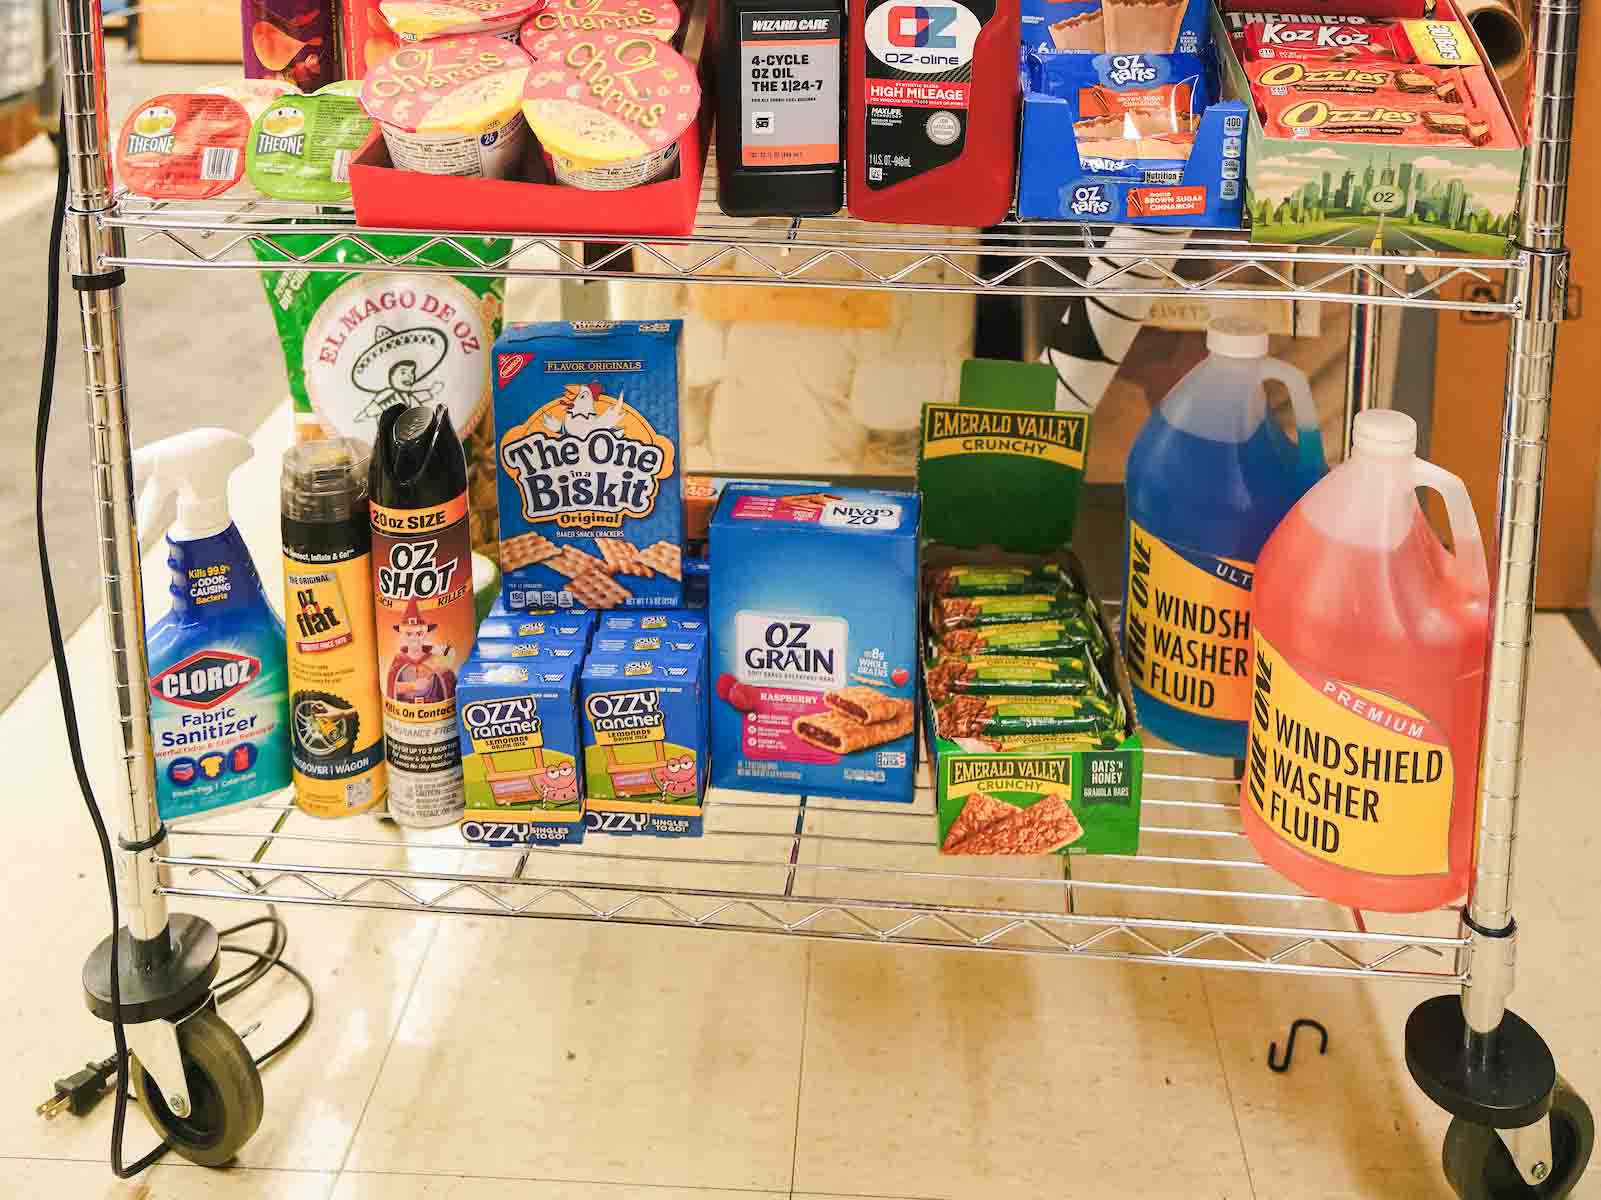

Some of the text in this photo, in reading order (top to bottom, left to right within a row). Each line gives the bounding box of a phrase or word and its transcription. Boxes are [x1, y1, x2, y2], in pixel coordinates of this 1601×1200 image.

[536, 7, 657, 32] Charms
[752, 19, 830, 31] WIZARD CARE
[887, 5, 958, 49] OZ
[1262, 23, 1369, 47] Koz Koz
[1038, 42, 1049, 55] 6
[1180, 45, 1197, 53] USA
[751, 54, 809, 66] 4-CYCLE
[885, 53, 959, 65] OZ-oline
[1112, 55, 1145, 70] OZ
[373, 52, 506, 97] Charms
[751, 67, 794, 79] OZ OIL
[1110, 65, 1156, 85] tarts
[1260, 63, 1388, 86] Ozzies
[565, 42, 667, 128] Charms
[751, 81, 778, 92] THE
[870, 85, 964, 101] HIGH MILEAGE
[871, 107, 902, 115] MAXLIFE
[1281, 101, 1418, 127] Ozzies
[1226, 118, 1241, 127] 400
[128, 134, 175, 154] THEONE
[258, 134, 304, 155] THEONE
[483, 135, 496, 145] 26
[1146, 171, 1177, 181] Nutrition
[1075, 186, 1101, 202] OZ
[1144, 194, 1203, 204] BROWN SUGAR
[1071, 198, 1110, 215] tarts
[1149, 202, 1195, 210] CINNAMON
[320, 335, 347, 366] EL
[340, 289, 417, 332] MAGO
[420, 293, 458, 324] DE
[453, 320, 482, 355] OZ
[547, 361, 642, 371] FLAVOR ORIGINALS
[933, 410, 1080, 449] EMERALD VALLEY
[962, 438, 1048, 455] CRUNCHY
[508, 434, 659, 477] The One
[526, 470, 649, 513] Biskit
[373, 510, 446, 529] 20 SIZE
[560, 513, 619, 524] Original
[832, 506, 894, 517] GRAIN
[847, 515, 879, 525] OZ
[576, 530, 595, 538] SNACK
[596, 530, 625, 538] CRACKERS
[311, 552, 331, 561] Inflate
[390, 540, 438, 572] OZ
[189, 568, 207, 579] Kills
[197, 574, 228, 588] ODOR-
[289, 574, 329, 584] THE ORIGINAL
[379, 558, 458, 598] SHOT
[1131, 537, 1152, 609] ONE
[190, 582, 232, 598] CAUSING
[1154, 587, 1250, 641] WINDSH
[764, 622, 811, 648] OZ
[871, 648, 885, 660] 8g
[1153, 625, 1249, 677] WASHER
[745, 647, 834, 675] GRAIN
[859, 657, 889, 669] WHOLE
[162, 659, 251, 699] CLOROZ
[857, 665, 888, 677] GRAINS
[1151, 661, 1216, 709] FLUID
[589, 691, 658, 718] OZZY
[760, 692, 818, 705] RASPBERRY
[182, 707, 236, 728] Fabric
[402, 708, 416, 719] On
[466, 699, 533, 728] OZZY
[1322, 680, 1425, 739] PREMIUM
[472, 718, 539, 739] rancher
[595, 712, 661, 731] rancher
[162, 714, 257, 748] Sanitizer
[1249, 649, 1273, 812] THE ONE
[1275, 706, 1444, 784] WINDSHIELD
[335, 757, 369, 775] WAGON
[954, 760, 1065, 784] EMERALD VALLEY
[1091, 760, 1115, 773] OATS
[976, 781, 1044, 792] CRUNCHY
[1091, 772, 1123, 785] HONEY
[1273, 749, 1380, 824] WASHER
[1083, 787, 1129, 797] GRANOLA BARS
[586, 811, 646, 832] OZZY
[652, 818, 689, 827] SINGLES
[1271, 790, 1341, 854] FLUID
[462, 821, 528, 841] OZZY
[530, 827, 569, 835] SINGLES
